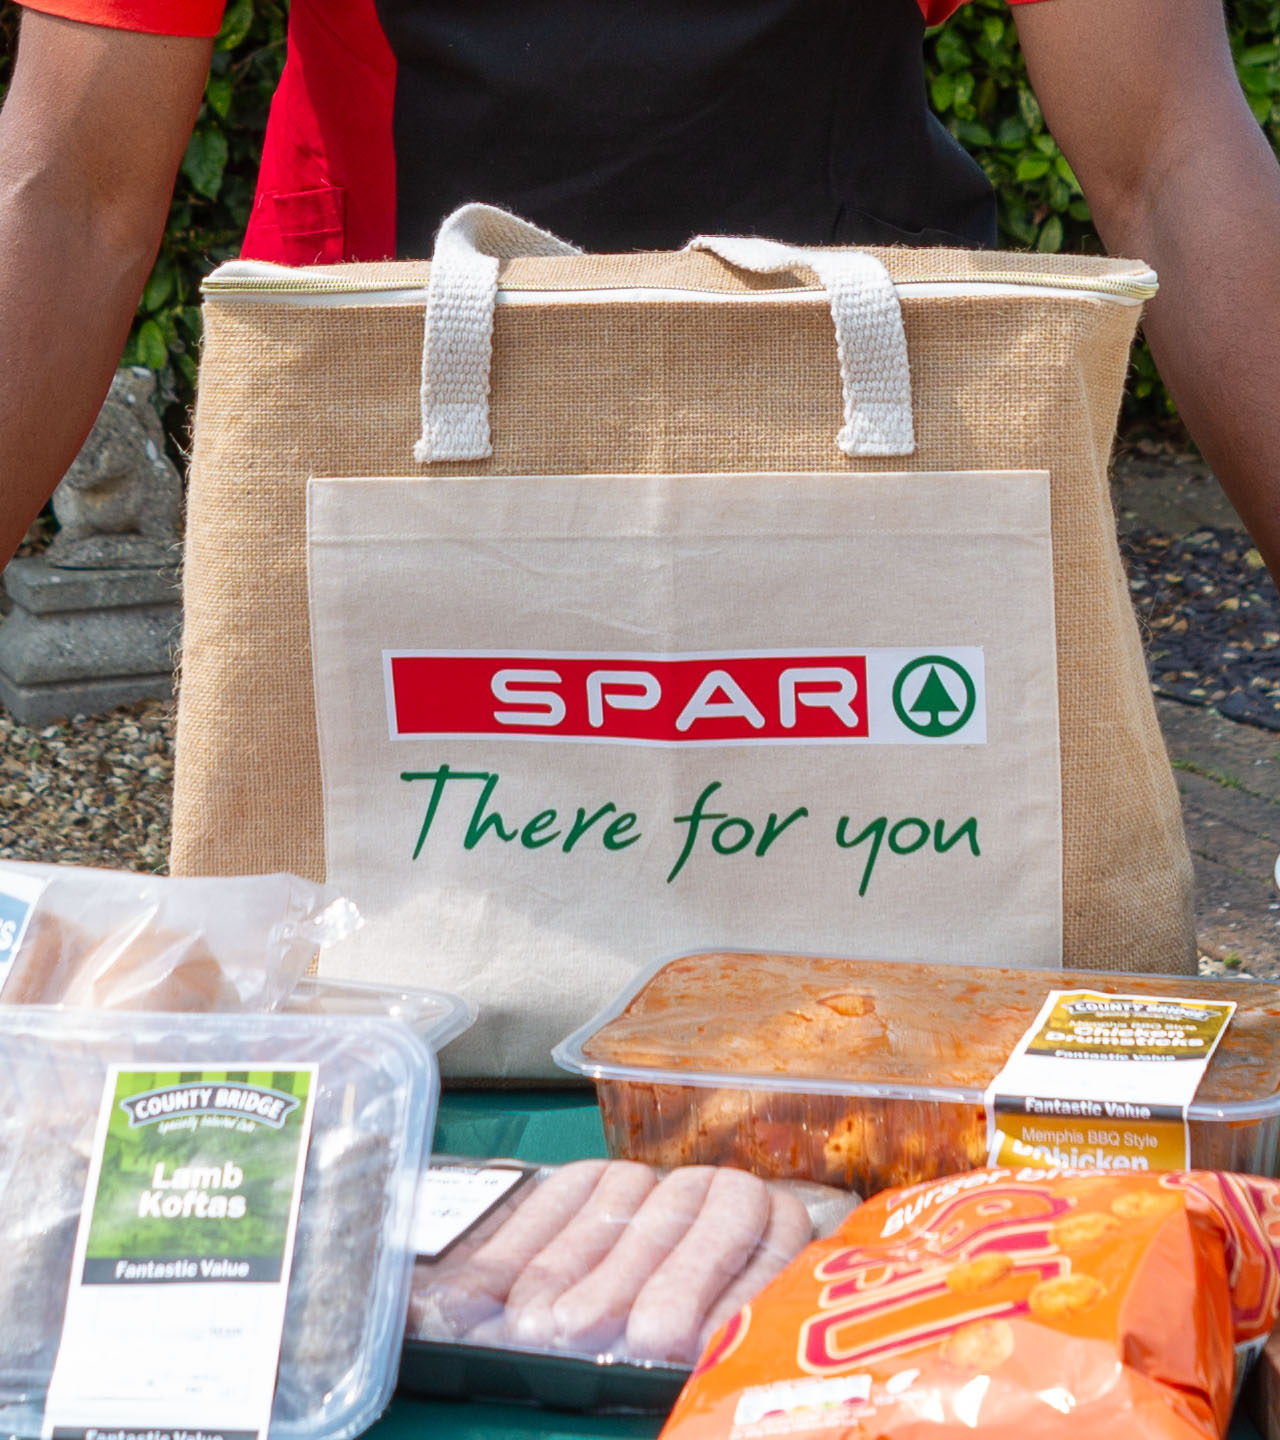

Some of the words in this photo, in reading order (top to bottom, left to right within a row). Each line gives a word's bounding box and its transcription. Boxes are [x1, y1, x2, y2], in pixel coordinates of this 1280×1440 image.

[490, 667, 860, 732] SPAR
[400, 763, 642, 861] There
[666, 780, 810, 884] for
[836, 808, 982, 897] you
[135, 1087, 213, 1119] COUNTY
[214, 1087, 285, 1119] BRIDGE
[1024, 1096, 1101, 1116] Fantastic
[1103, 1102, 1151, 1119] Value
[1022, 1126, 1084, 1145] Memphis
[1087, 1130, 1120, 1146] BBQ
[1123, 1131, 1159, 1150] Style
[152, 1161, 244, 1189] Lamb
[137, 1190, 248, 1219] Koftas
[880, 1168, 1011, 1238] Burger
[115, 1260, 198, 1279] Fantastic
[200, 1259, 250, 1278] Value
